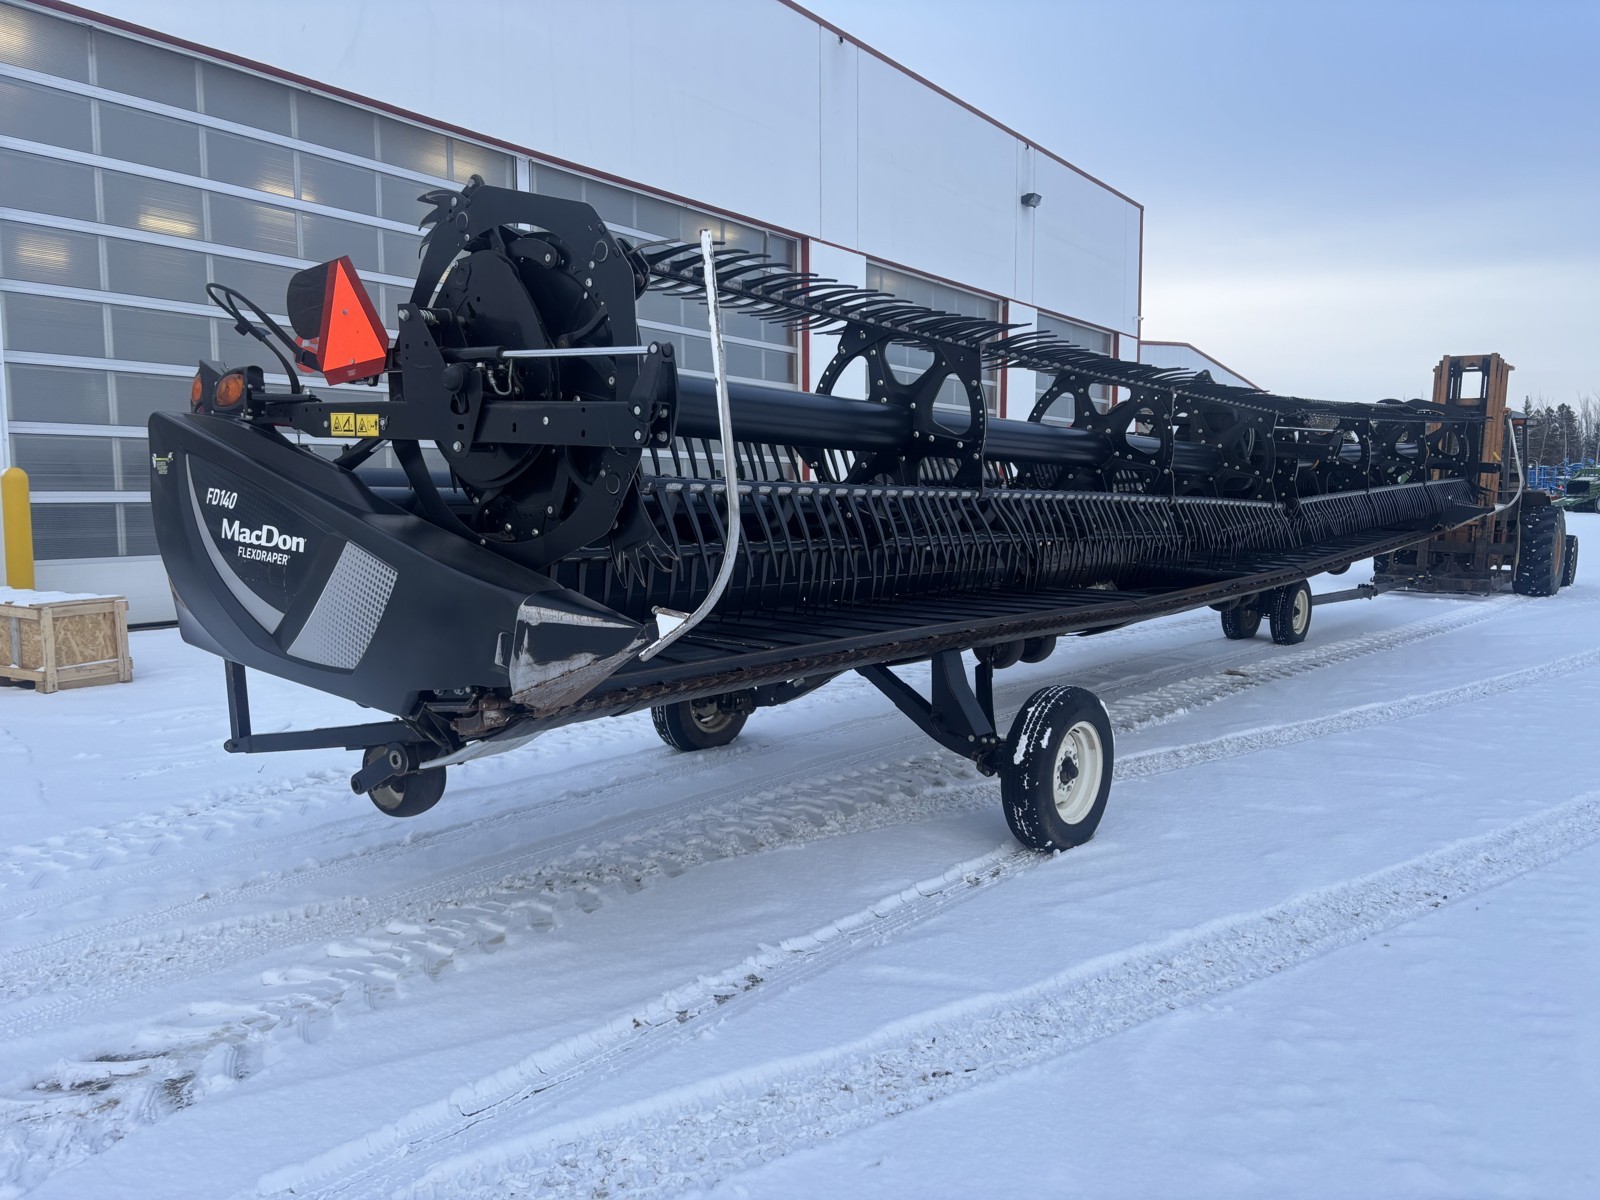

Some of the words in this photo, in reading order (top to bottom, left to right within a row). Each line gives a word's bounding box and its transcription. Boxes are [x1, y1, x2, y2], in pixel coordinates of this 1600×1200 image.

[206, 487, 238, 510] FD140
[221, 518, 306, 553] MacDon
[237, 546, 289, 566] FLEXDRAPER
